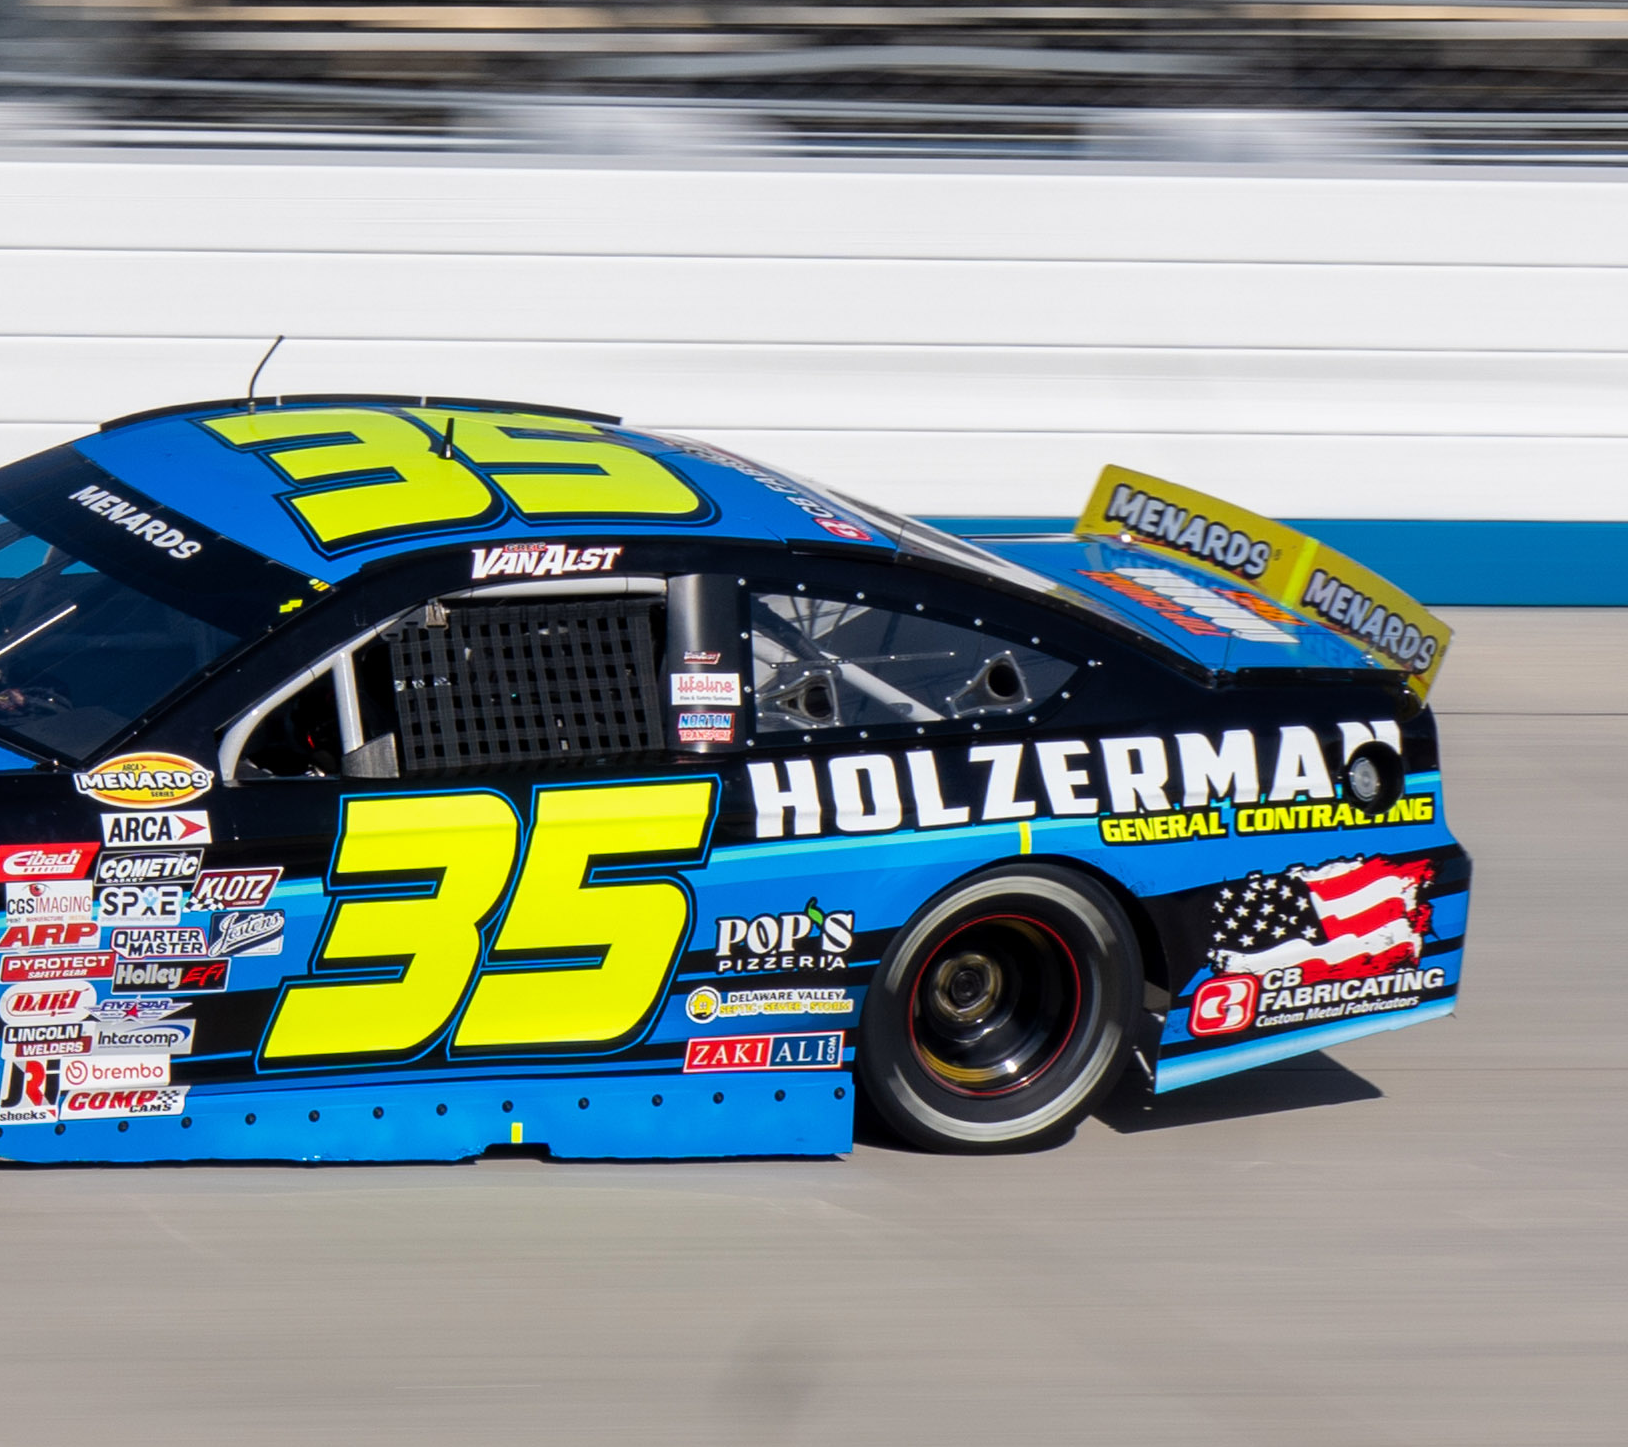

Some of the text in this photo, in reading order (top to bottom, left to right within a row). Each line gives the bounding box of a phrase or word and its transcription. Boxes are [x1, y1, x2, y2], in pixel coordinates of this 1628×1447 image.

[202, 407, 700, 543] 35
[68, 485, 202, 559] MENARDS
[1105, 484, 1271, 579] MENARDS
[1302, 569, 1437, 674] MENARDS
[678, 676, 735, 693] lifeline
[680, 714, 732, 727] NORTON
[79, 770, 210, 791] MENARDS
[108, 816, 173, 843] ARCA
[1101, 811, 1227, 843] GENERAL
[3, 850, 81, 875] Eibach
[99, 853, 199, 880] COMETIC
[197, 874, 272, 901] KLOTZ
[263, 781, 712, 1058] 35
[114, 930, 200, 948] QUARTER
[128, 942, 204, 957] MASTER
[8, 955, 110, 971] PYROTECT
[28, 968, 87, 979] SAFETY GEAR
[718, 955, 847, 973] PIZZERIA
[117, 964, 184, 989] Holley
[1262, 967, 1303, 990] CB
[730, 990, 844, 1003] DELAWARE VALLEY
[1258, 968, 1446, 1012] FABRICATING
[11, 988, 90, 1016] DART
[1256, 996, 1419, 1027] Custom Metal Fabricators
[7, 1025, 79, 1043] LINCOLN
[98, 1031, 180, 1048] Intercomp
[22, 1043, 85, 1056] WELDERS
[692, 1042, 765, 1066] ZAKI
[774, 1039, 826, 1063] ALI
[92, 1063, 164, 1081] brembo
[67, 1090, 159, 1111] COMP
[129, 1104, 172, 1113] CAMS
[0, 1110, 47, 1122] shocks
